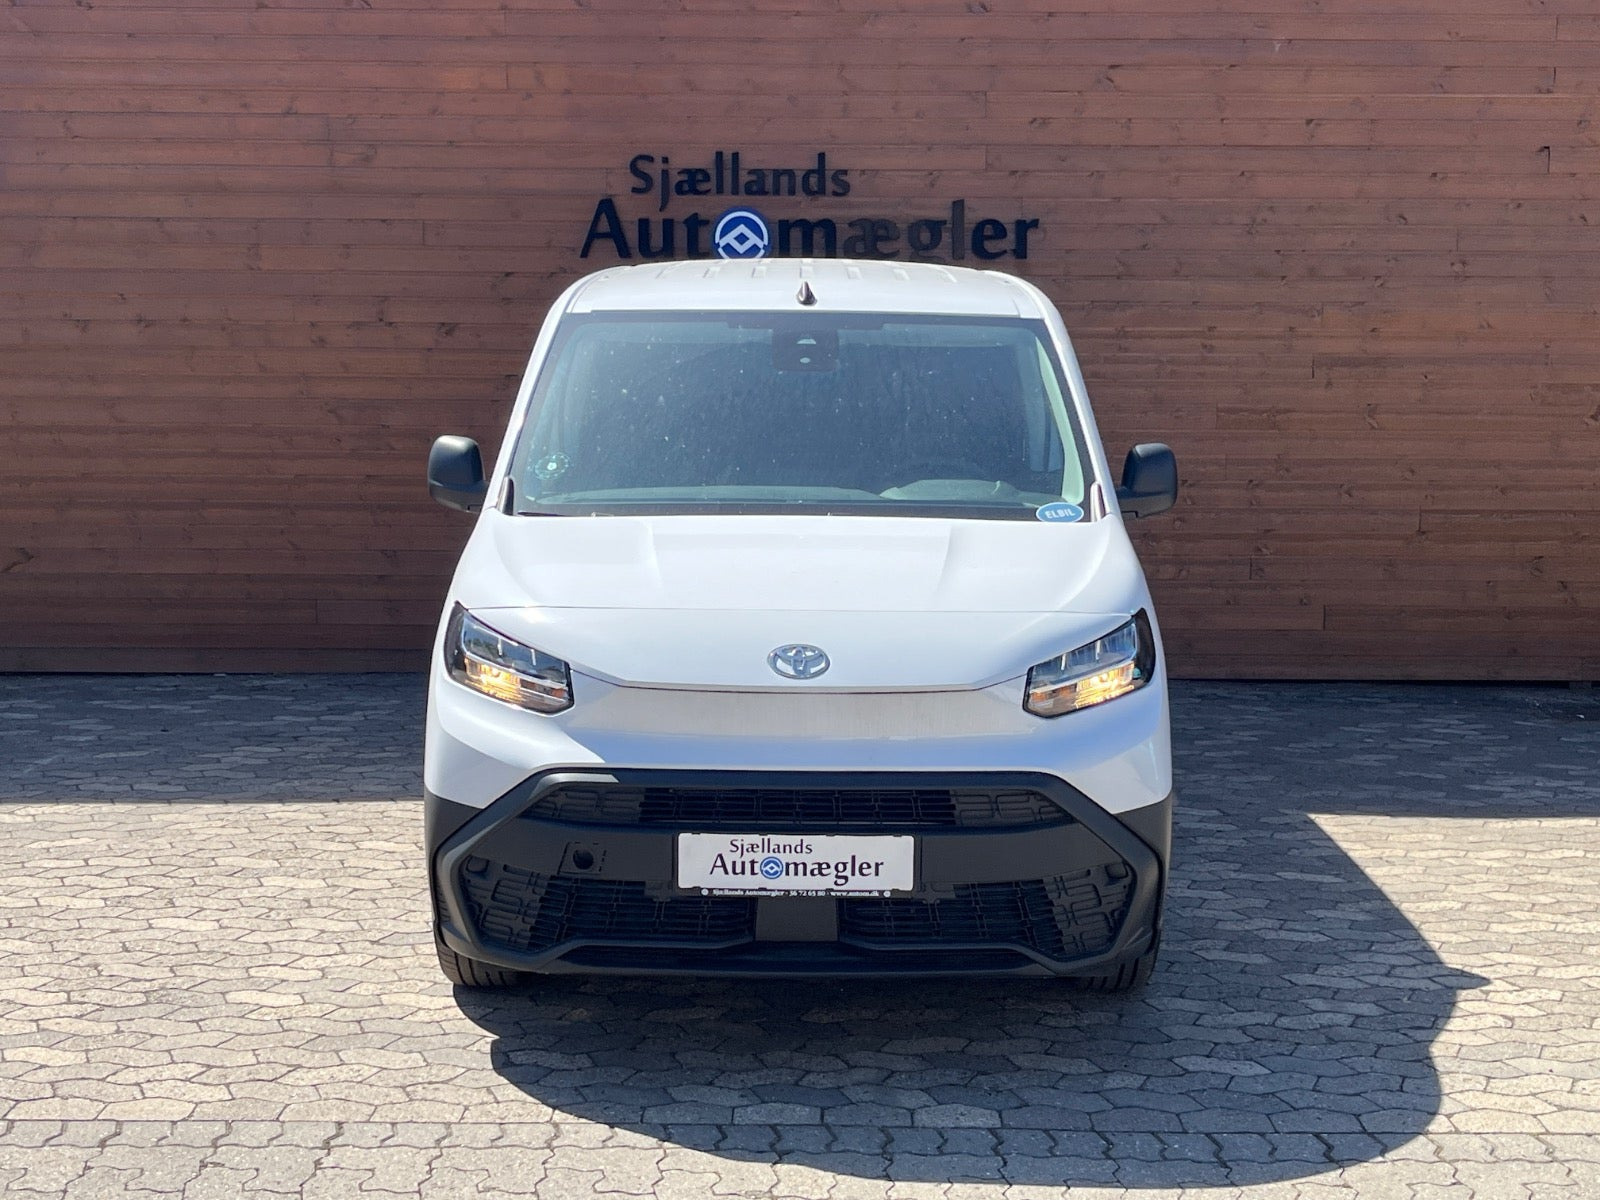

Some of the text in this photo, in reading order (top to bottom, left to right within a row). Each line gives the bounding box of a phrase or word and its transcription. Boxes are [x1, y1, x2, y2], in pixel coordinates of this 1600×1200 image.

[629, 151, 851, 211] Sjællands
[1045, 508, 1076, 519] ELBIL
[729, 838, 813, 858] Sjællands
